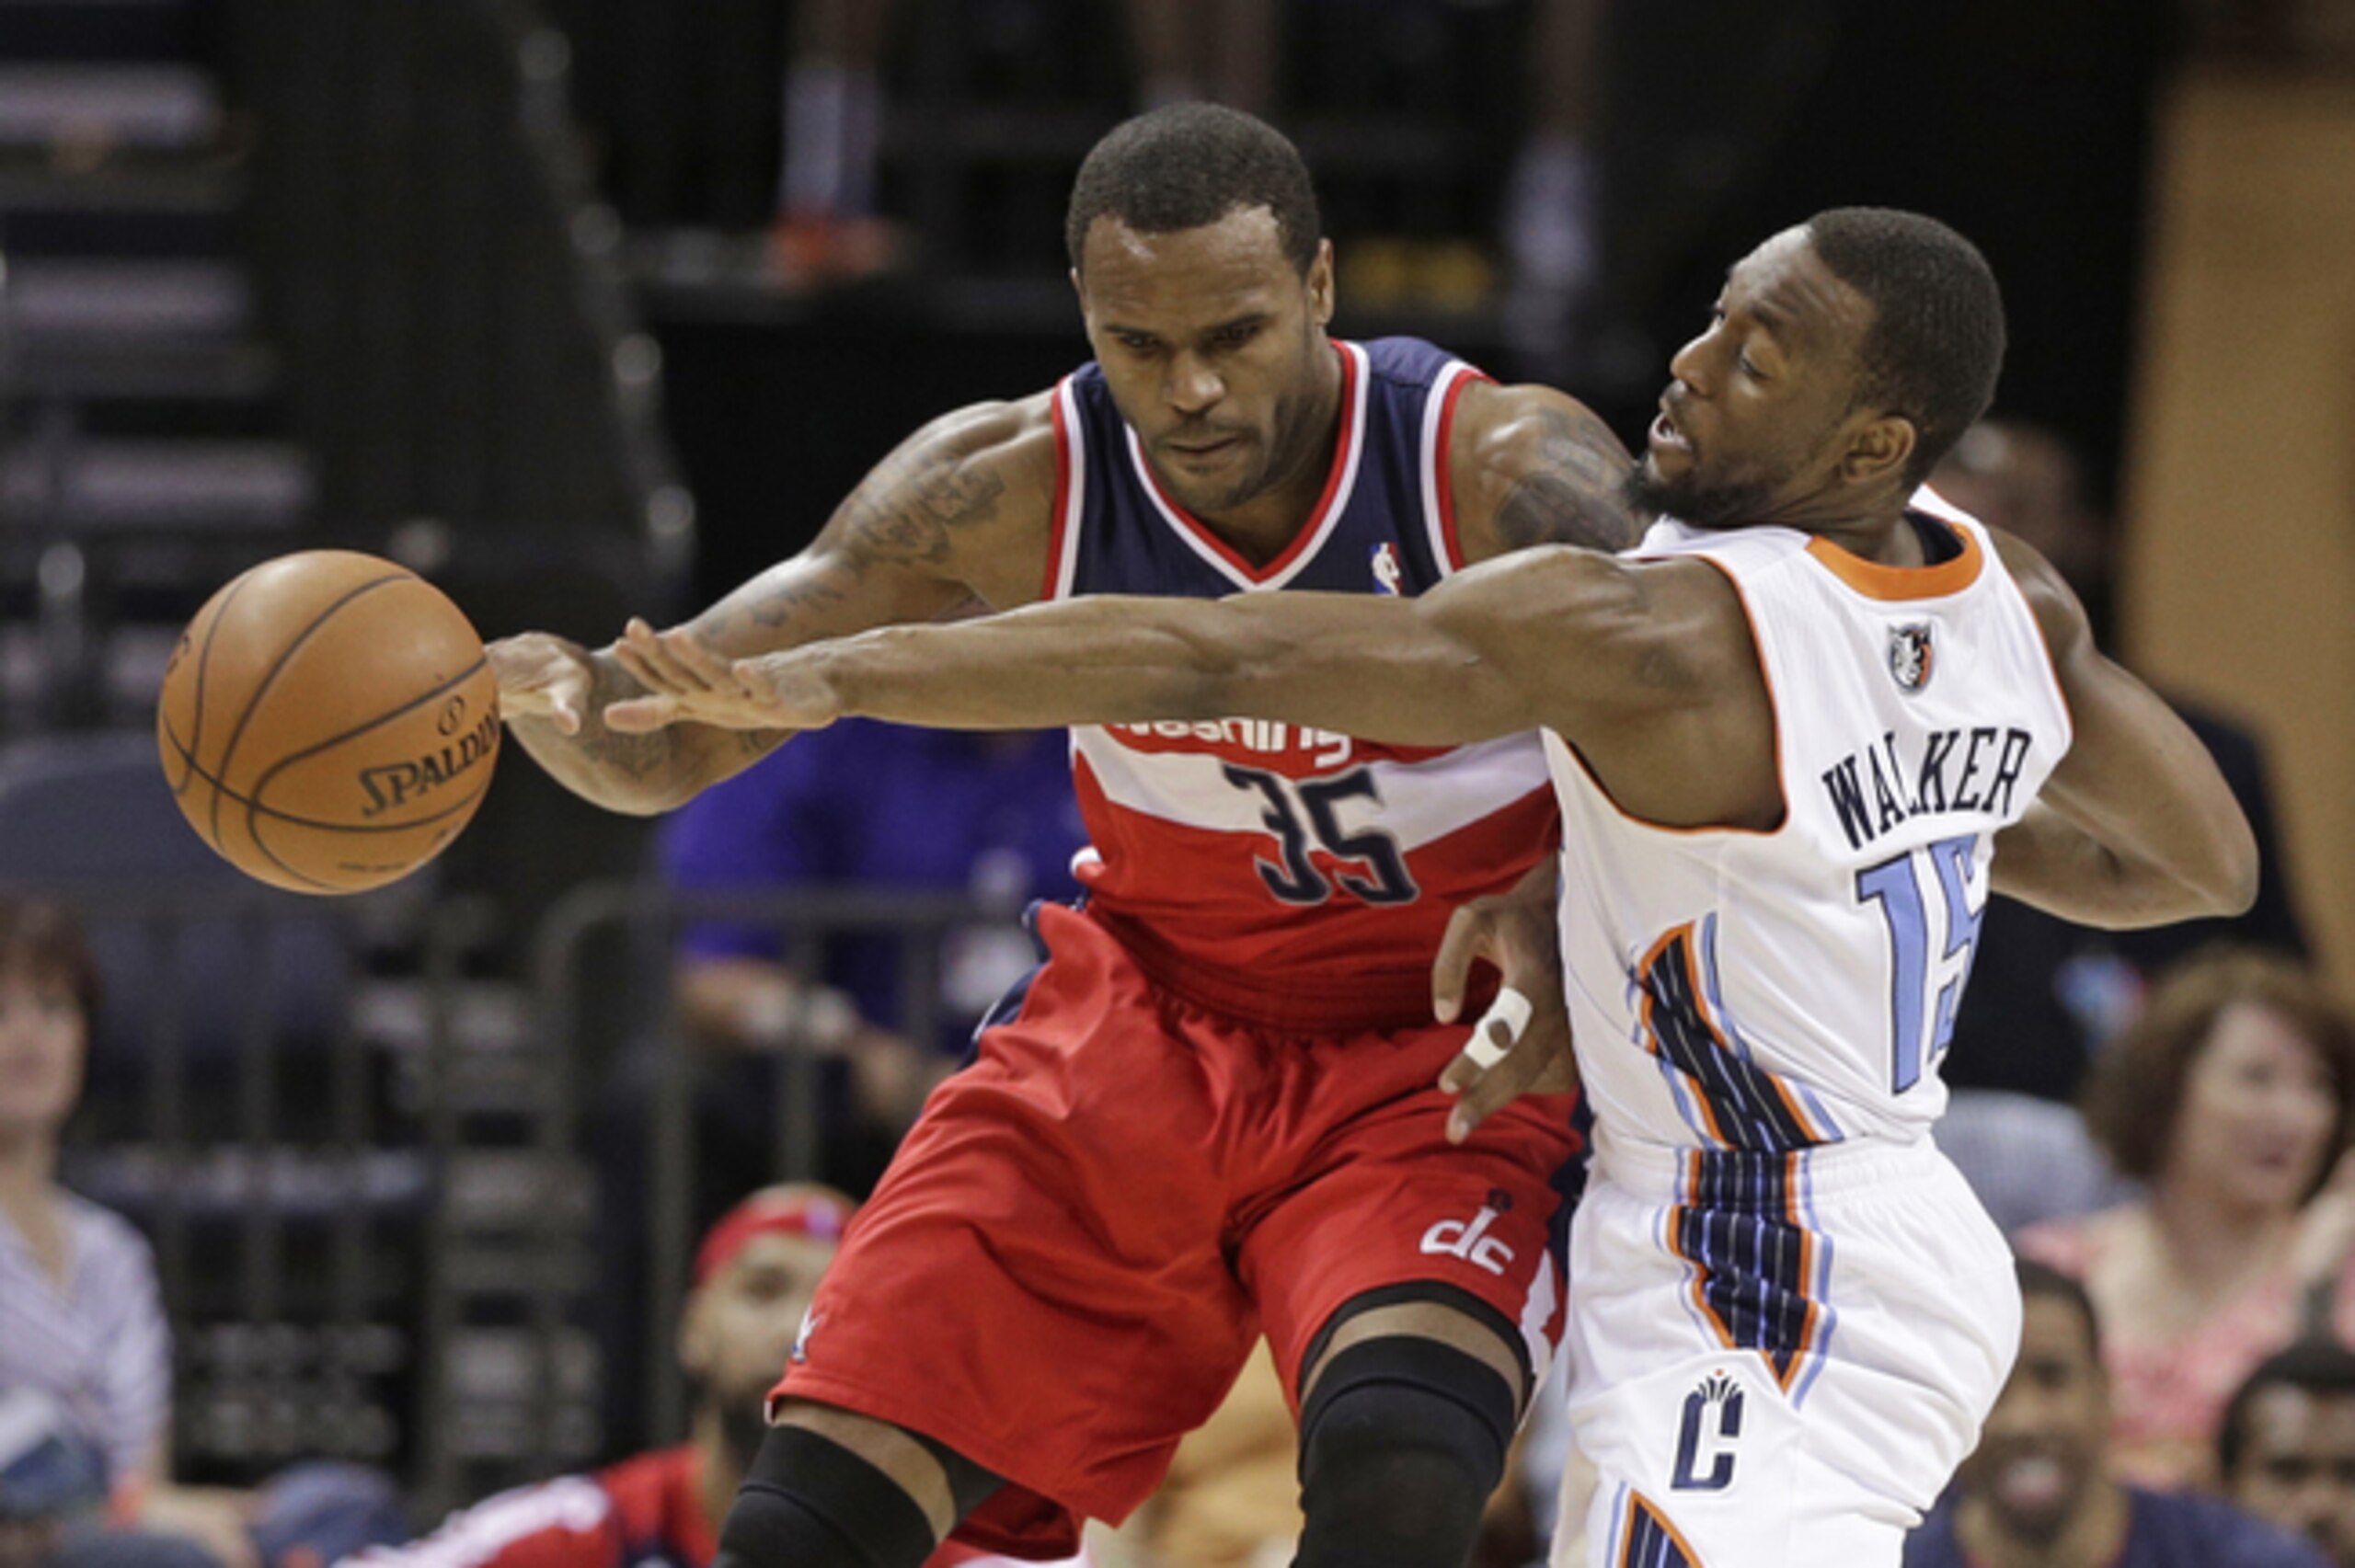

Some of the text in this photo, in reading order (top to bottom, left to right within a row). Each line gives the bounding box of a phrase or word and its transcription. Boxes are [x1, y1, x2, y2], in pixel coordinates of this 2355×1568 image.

[1222, 762, 1419, 905] 35
[1821, 727, 2032, 852] WALKER
[1855, 832, 1985, 1096] 15
